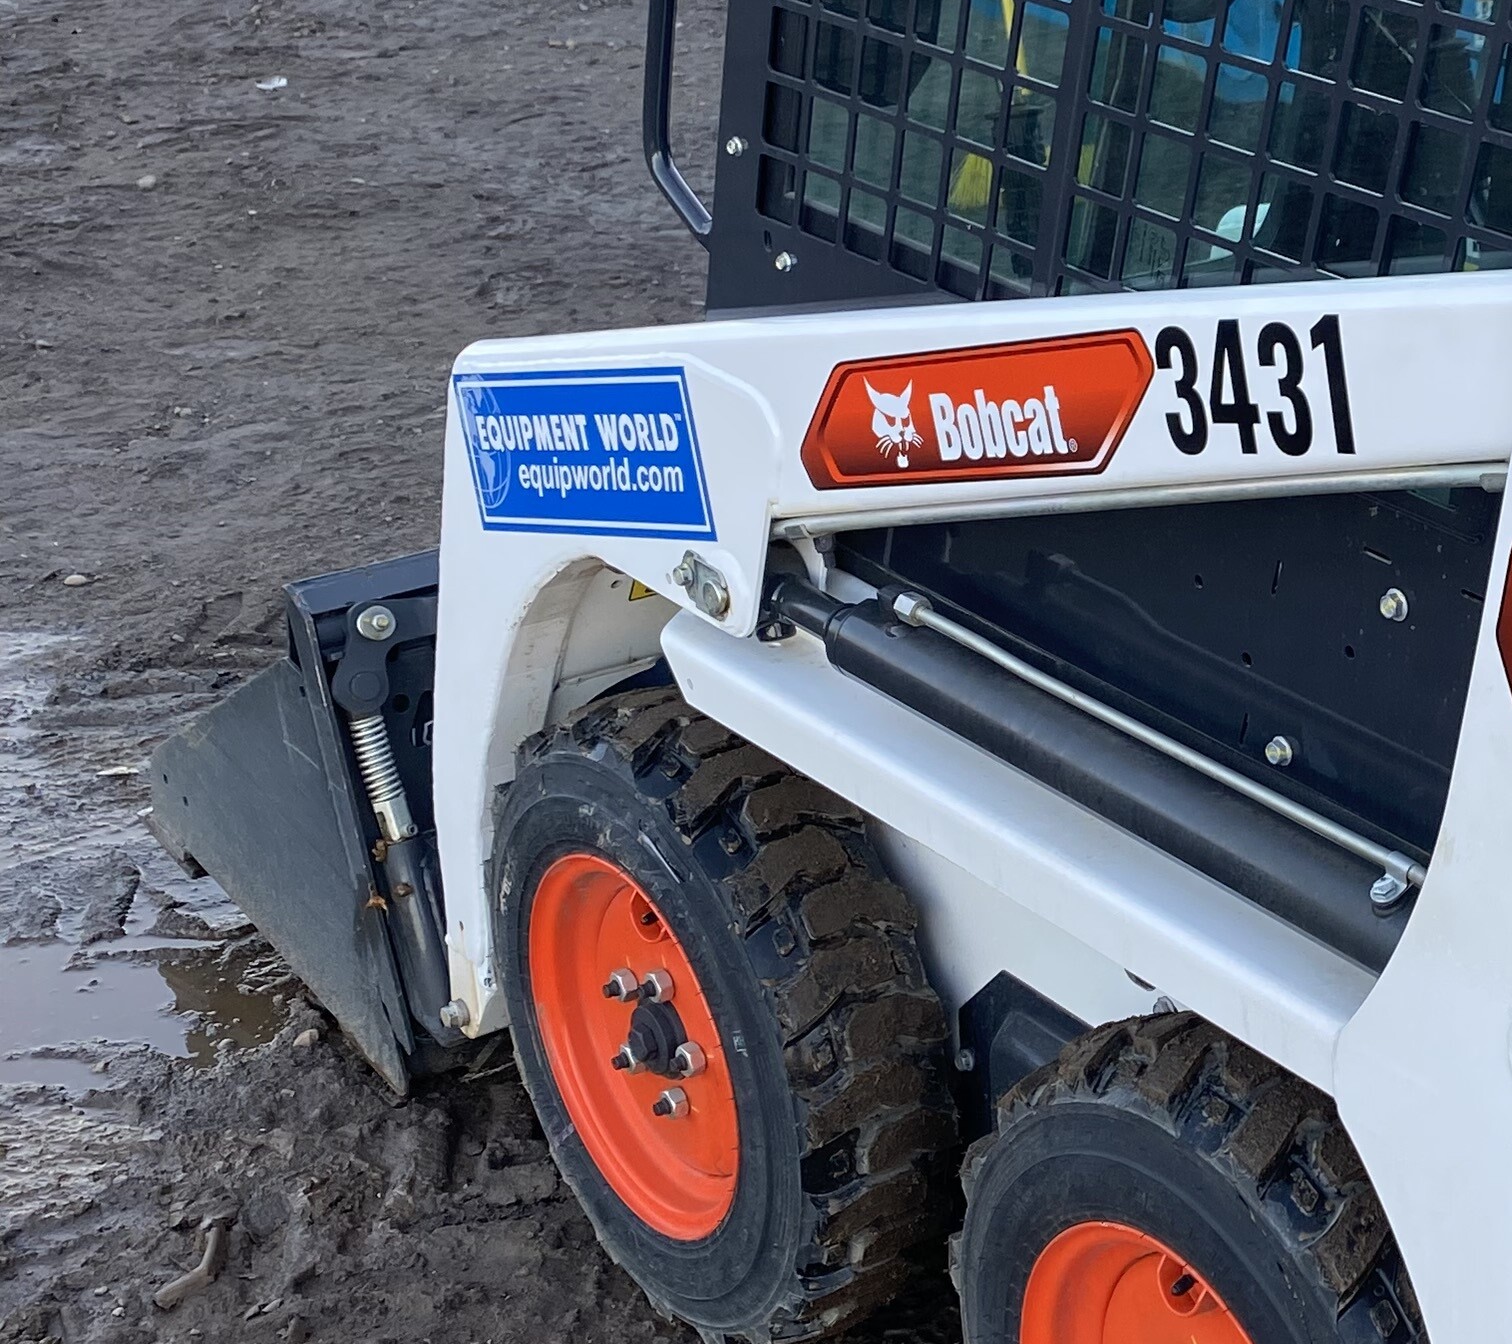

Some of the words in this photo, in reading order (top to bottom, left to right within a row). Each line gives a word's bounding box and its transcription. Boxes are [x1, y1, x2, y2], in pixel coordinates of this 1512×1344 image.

[1154, 314, 1356, 456] 3431
[475, 413, 590, 453] EQUIPMENT
[928, 384, 1070, 462] Bobcat
[518, 457, 684, 499] equipworld.com
